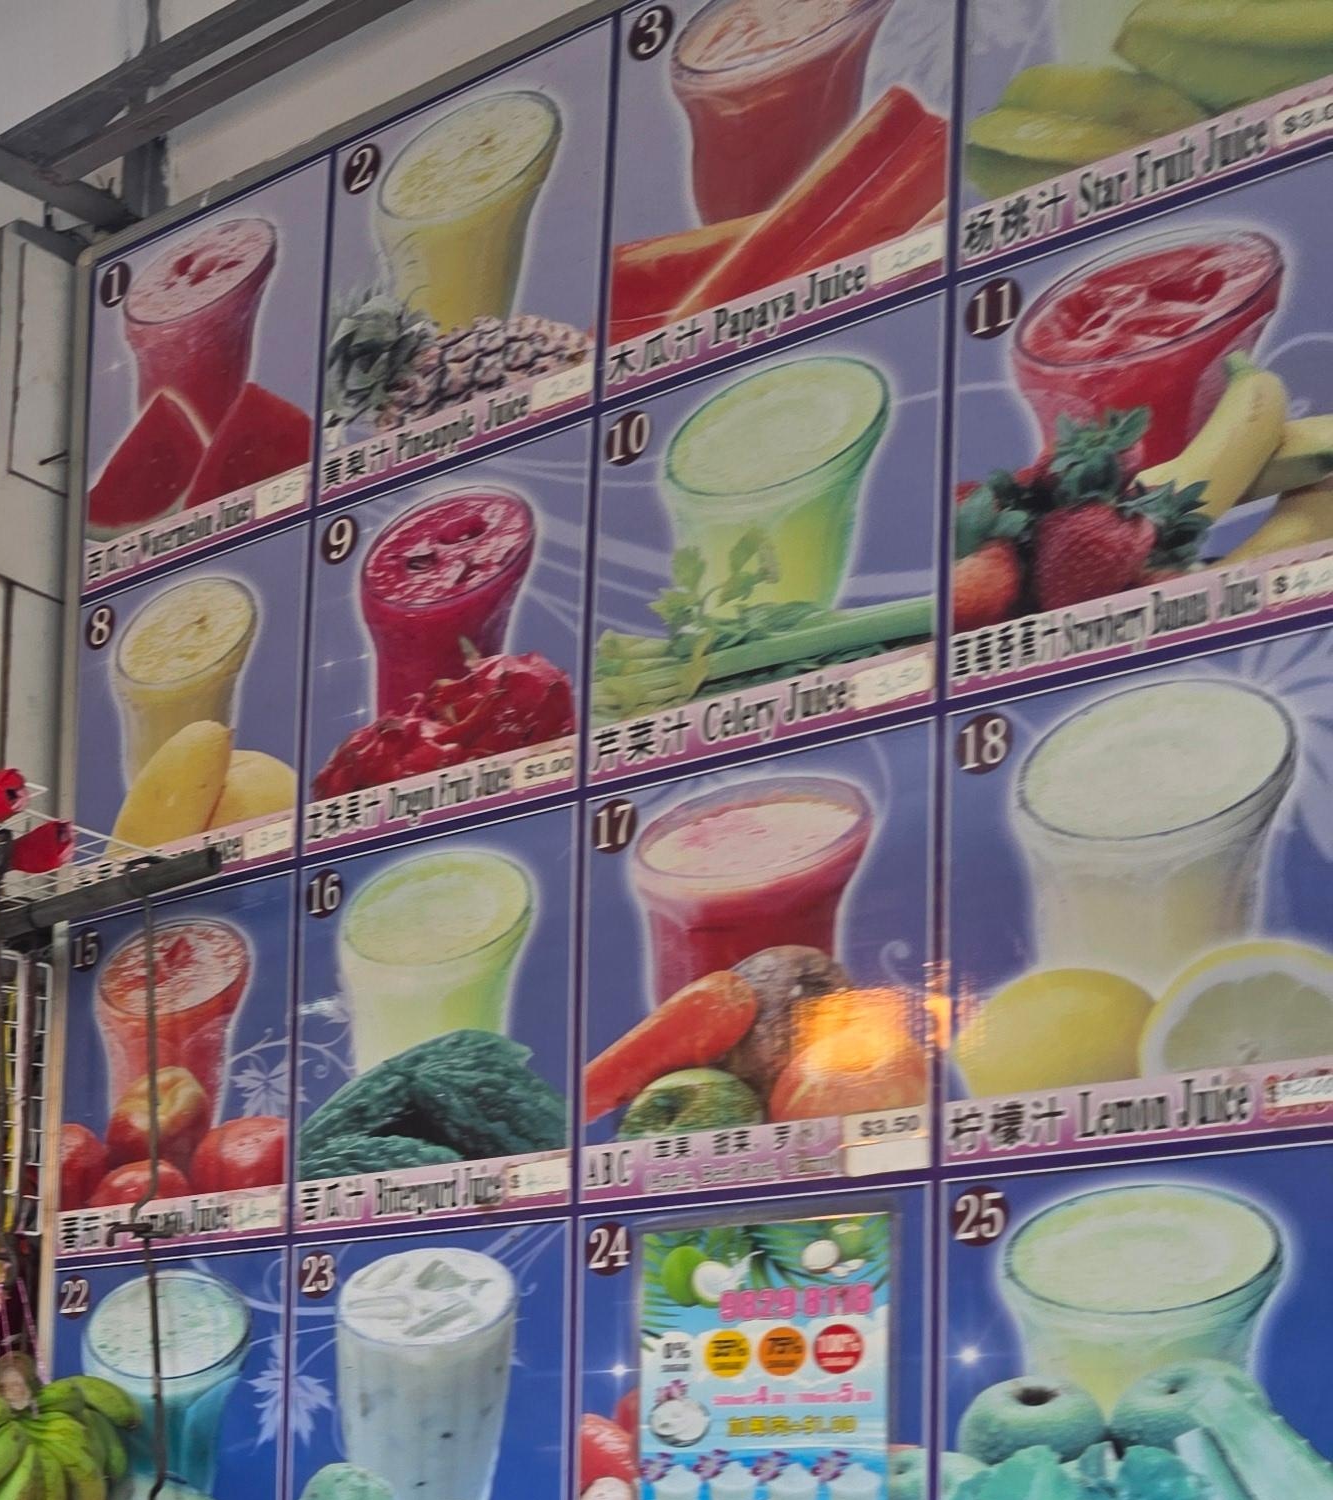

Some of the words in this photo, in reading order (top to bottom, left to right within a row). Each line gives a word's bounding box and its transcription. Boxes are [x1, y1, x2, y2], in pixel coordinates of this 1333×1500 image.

[637, 8, 664, 55] 3
[349, 147, 376, 191] 2
[1078, 167, 1125, 218] Star
[1134, 137, 1195, 197] Fruit
[1204, 118, 1267, 174] Juice
[106, 266, 122, 302] 1
[608, 324, 702, 383] 木瓜汁
[711, 290, 796, 348] Papaya
[805, 262, 867, 311] Juice
[972, 281, 1014, 334] 11
[395, 410, 475, 459] Pineapple
[484, 393, 529, 430] Juice
[609, 413, 650, 463] 10
[326, 519, 353, 561] 9
[1218, 576, 1262, 620] Juice
[90, 608, 111, 646] 8
[703, 695, 779, 743] Celery
[785, 675, 846, 722] Juice
[960, 718, 1007, 770] 18
[439, 771, 470, 807] Fruit
[476, 762, 511, 801] Juice
[597, 803, 631, 851] 17
[309, 873, 341, 914] 16
[73, 931, 99, 970] 15
[859, 1114, 921, 1138] $3.50
[1078, 1091, 1168, 1140] Lemon
[1178, 1074, 1252, 1129] Juice
[460, 1165, 503, 1206] Juice
[586, 1149, 631, 1187] ABC
[955, 1191, 1005, 1241] 25
[589, 1226, 631, 1269] 24
[301, 1254, 336, 1293] 23
[59, 1279, 89, 1314] 22
